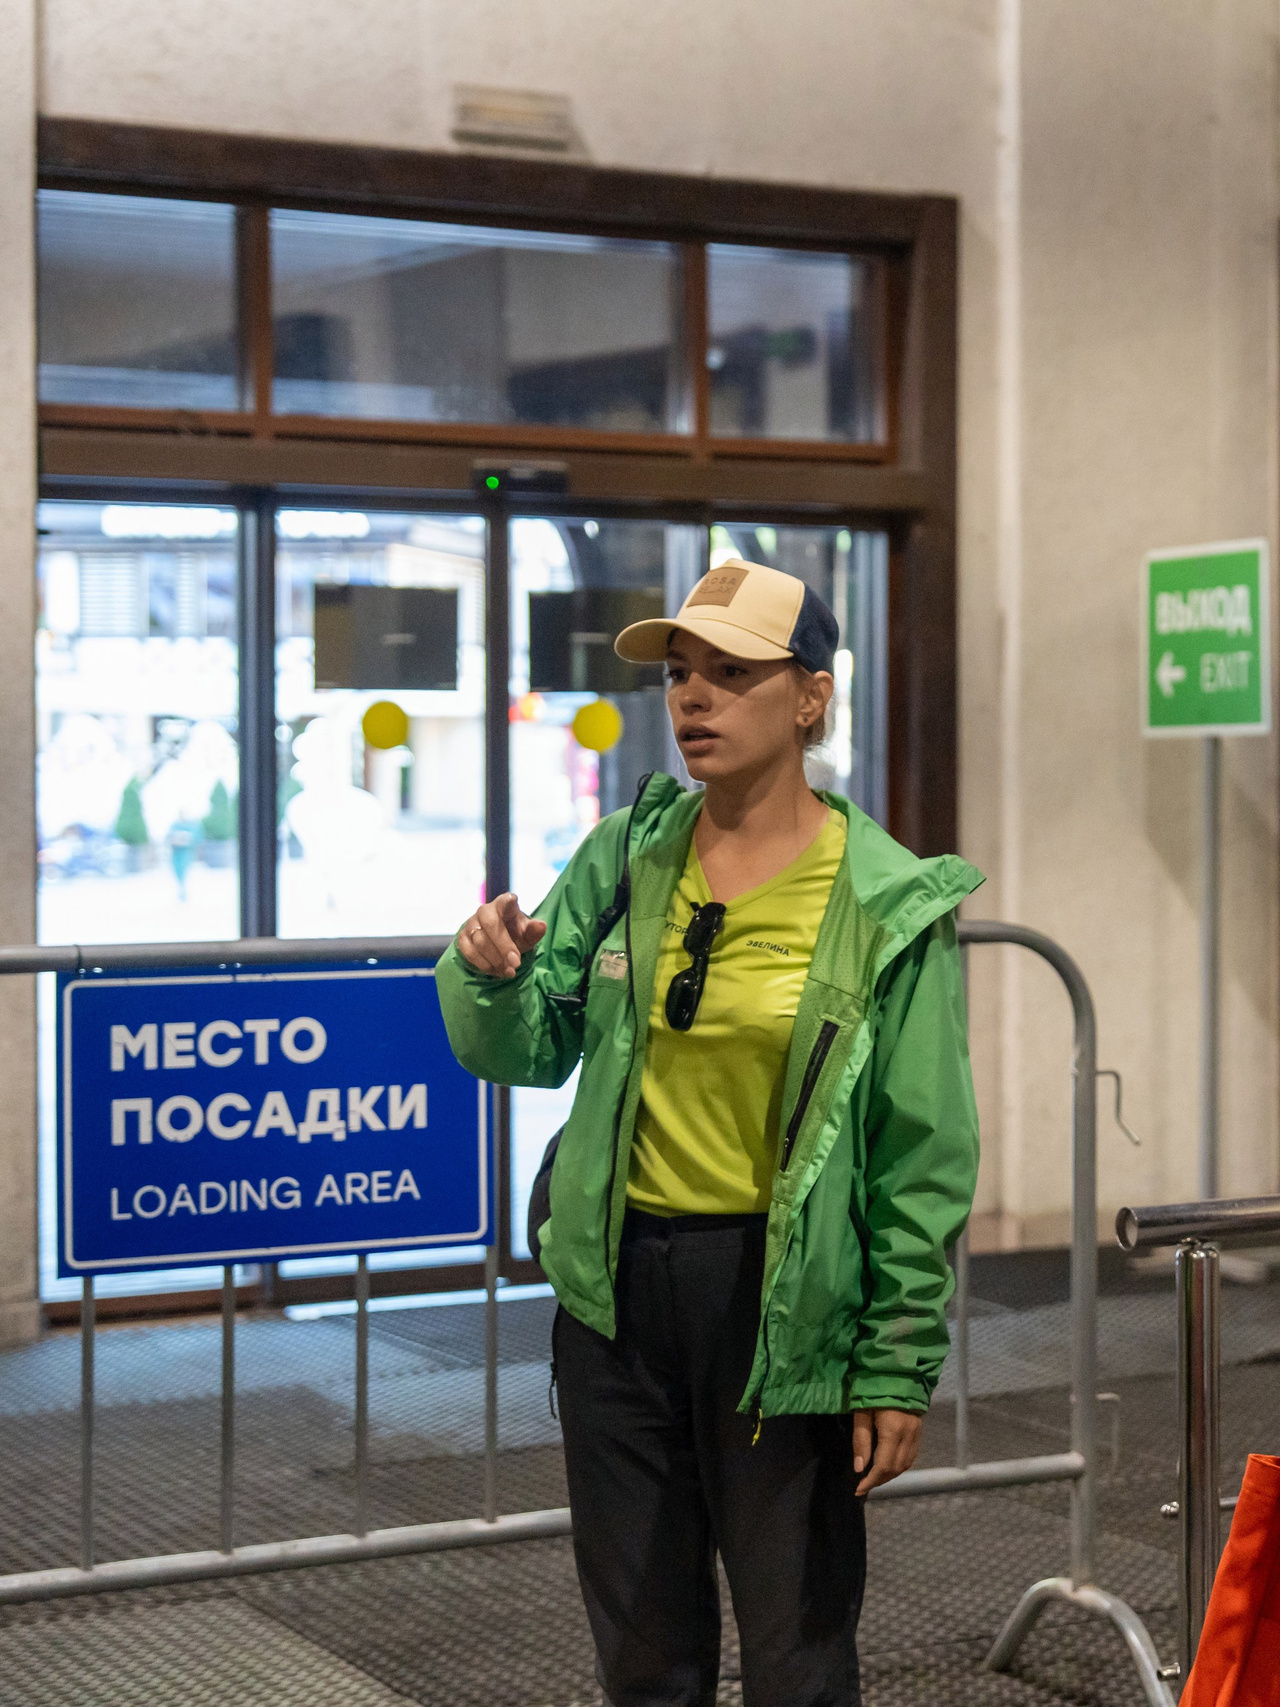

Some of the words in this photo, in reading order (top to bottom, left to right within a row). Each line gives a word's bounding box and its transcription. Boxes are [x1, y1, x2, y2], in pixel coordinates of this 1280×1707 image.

[1200, 651, 1251, 692] EXIT
[745, 939, 790, 957] ЭВЕЛИНА
[110, 1016, 328, 1071] МЕСТО
[110, 1084, 428, 1145] ПОСАДКИ
[110, 1176, 301, 1220] LOADING
[315, 1169, 421, 1206] AREA
